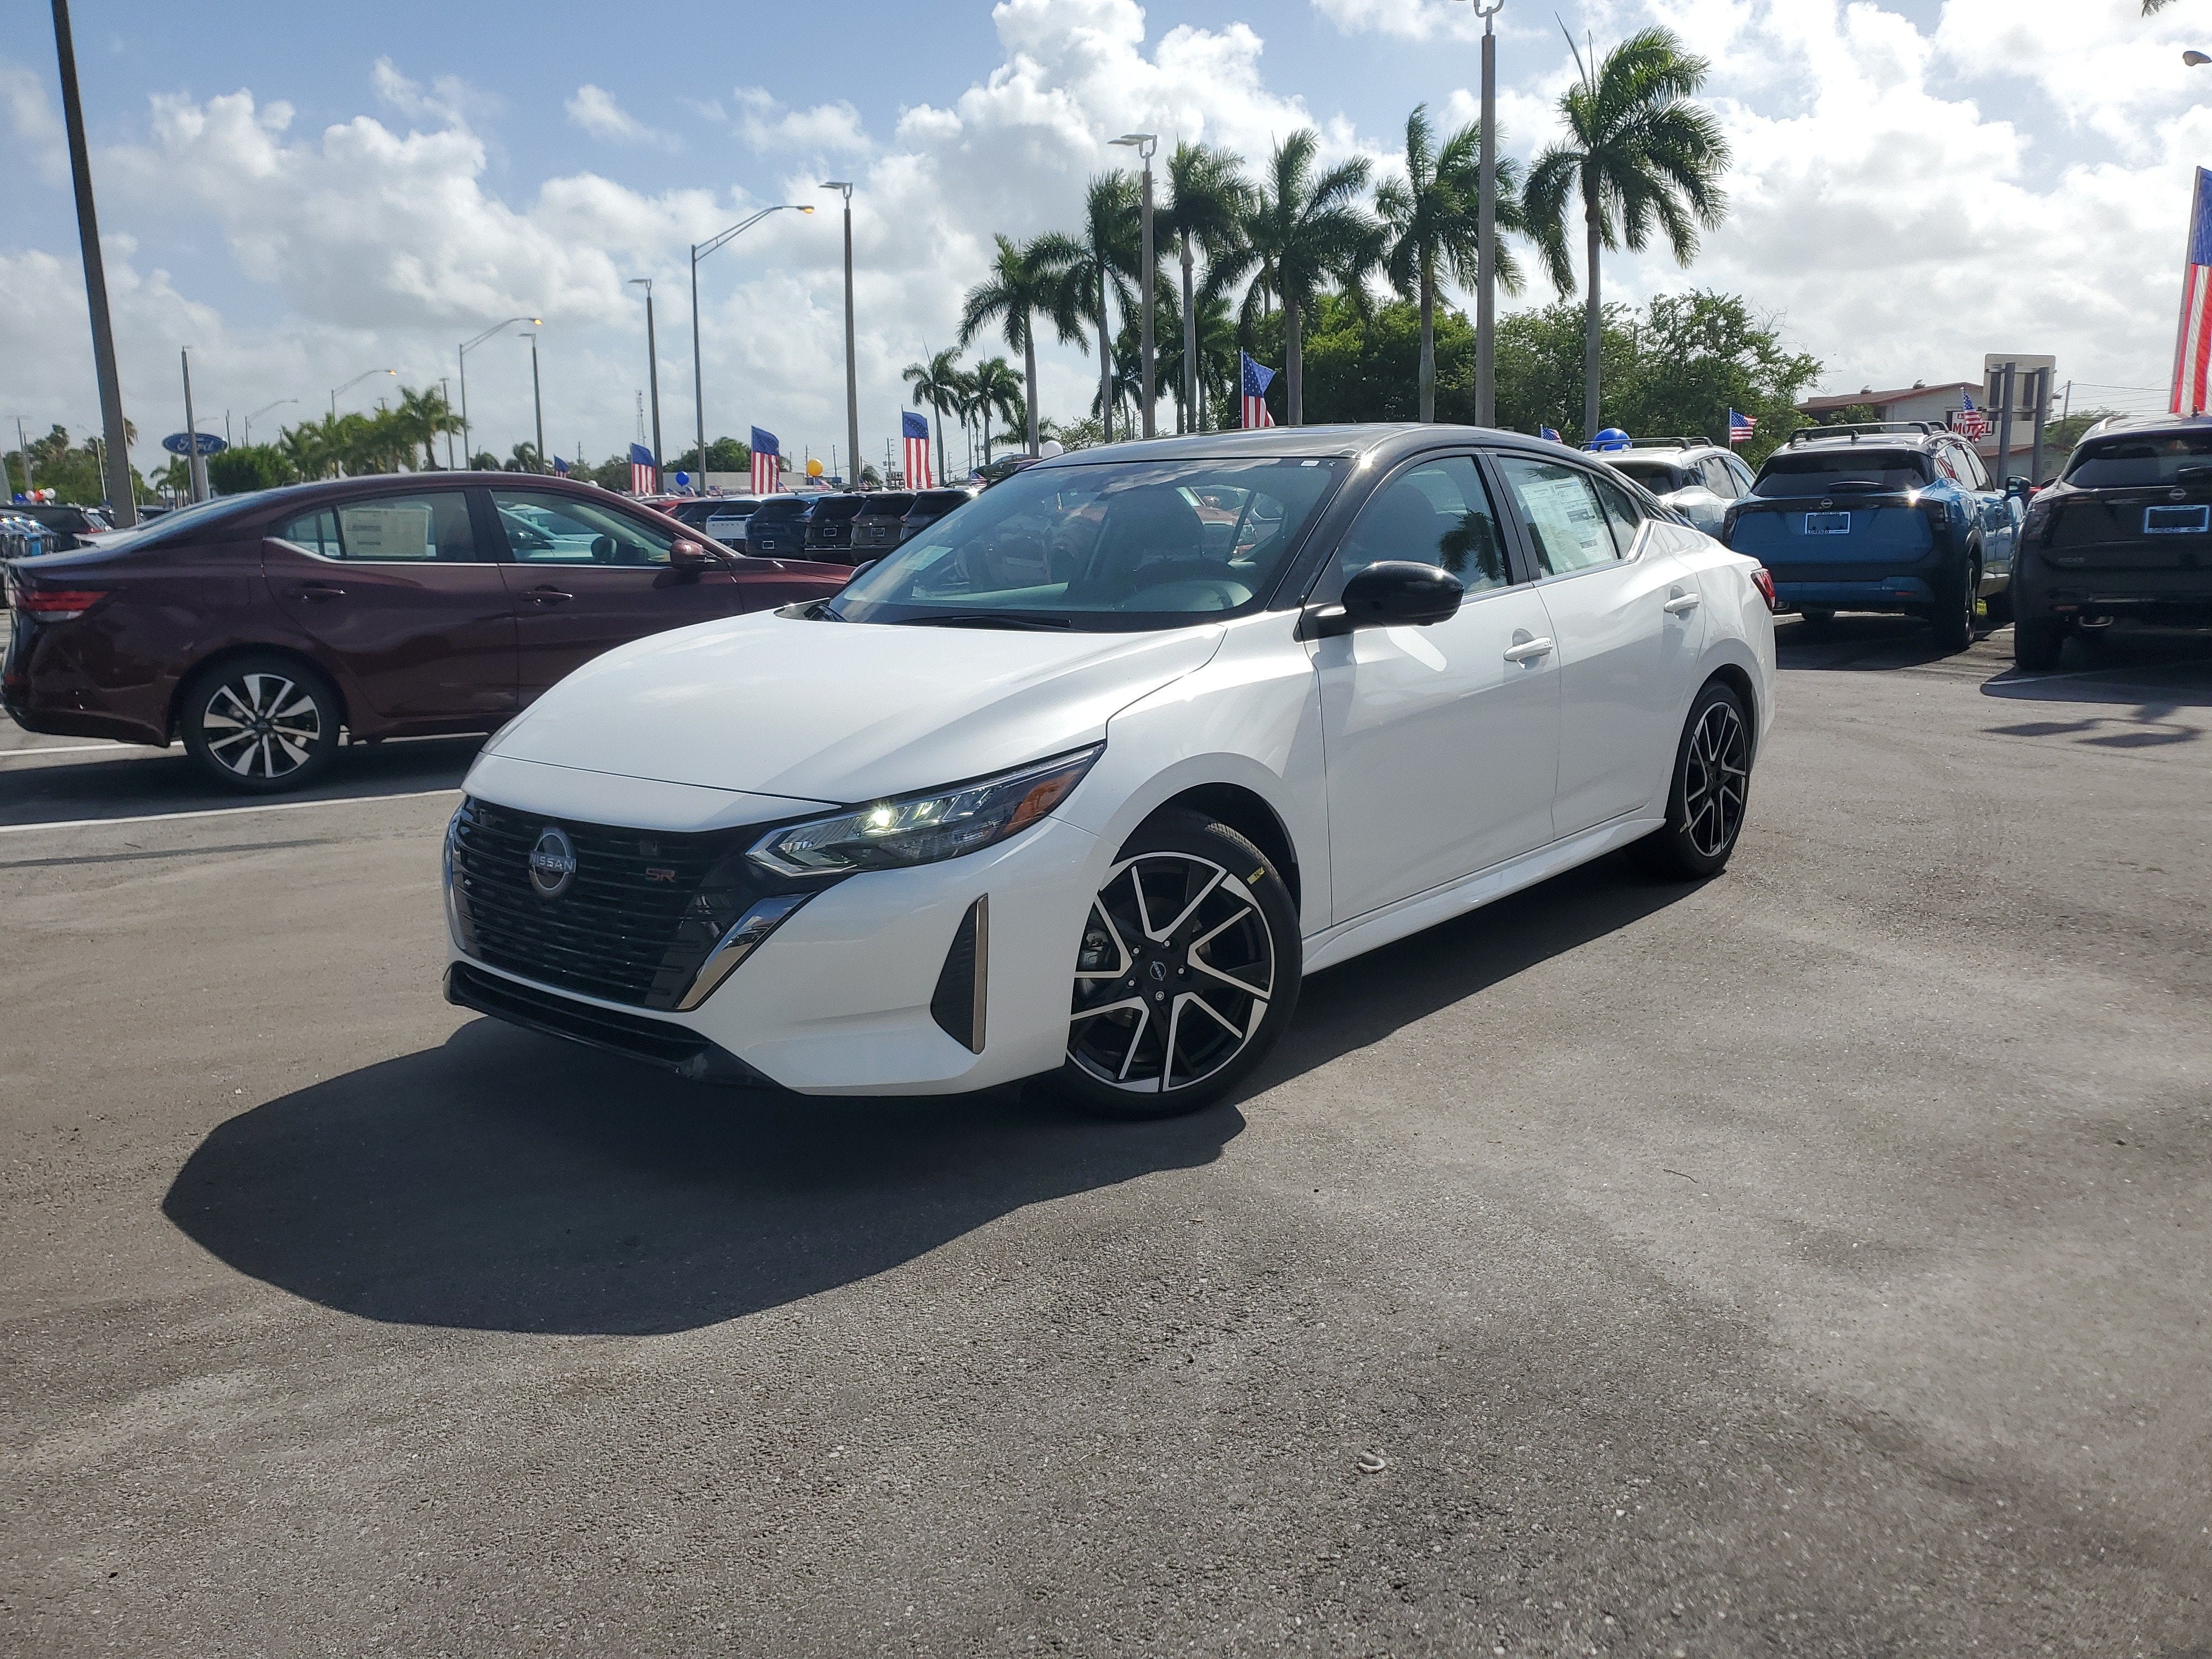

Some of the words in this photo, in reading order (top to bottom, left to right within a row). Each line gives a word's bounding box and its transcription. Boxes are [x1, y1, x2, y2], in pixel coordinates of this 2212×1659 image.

[1953, 422, 1991, 435] MOL
[531, 853, 573, 871] NISSAN
[646, 868, 676, 882] SR
